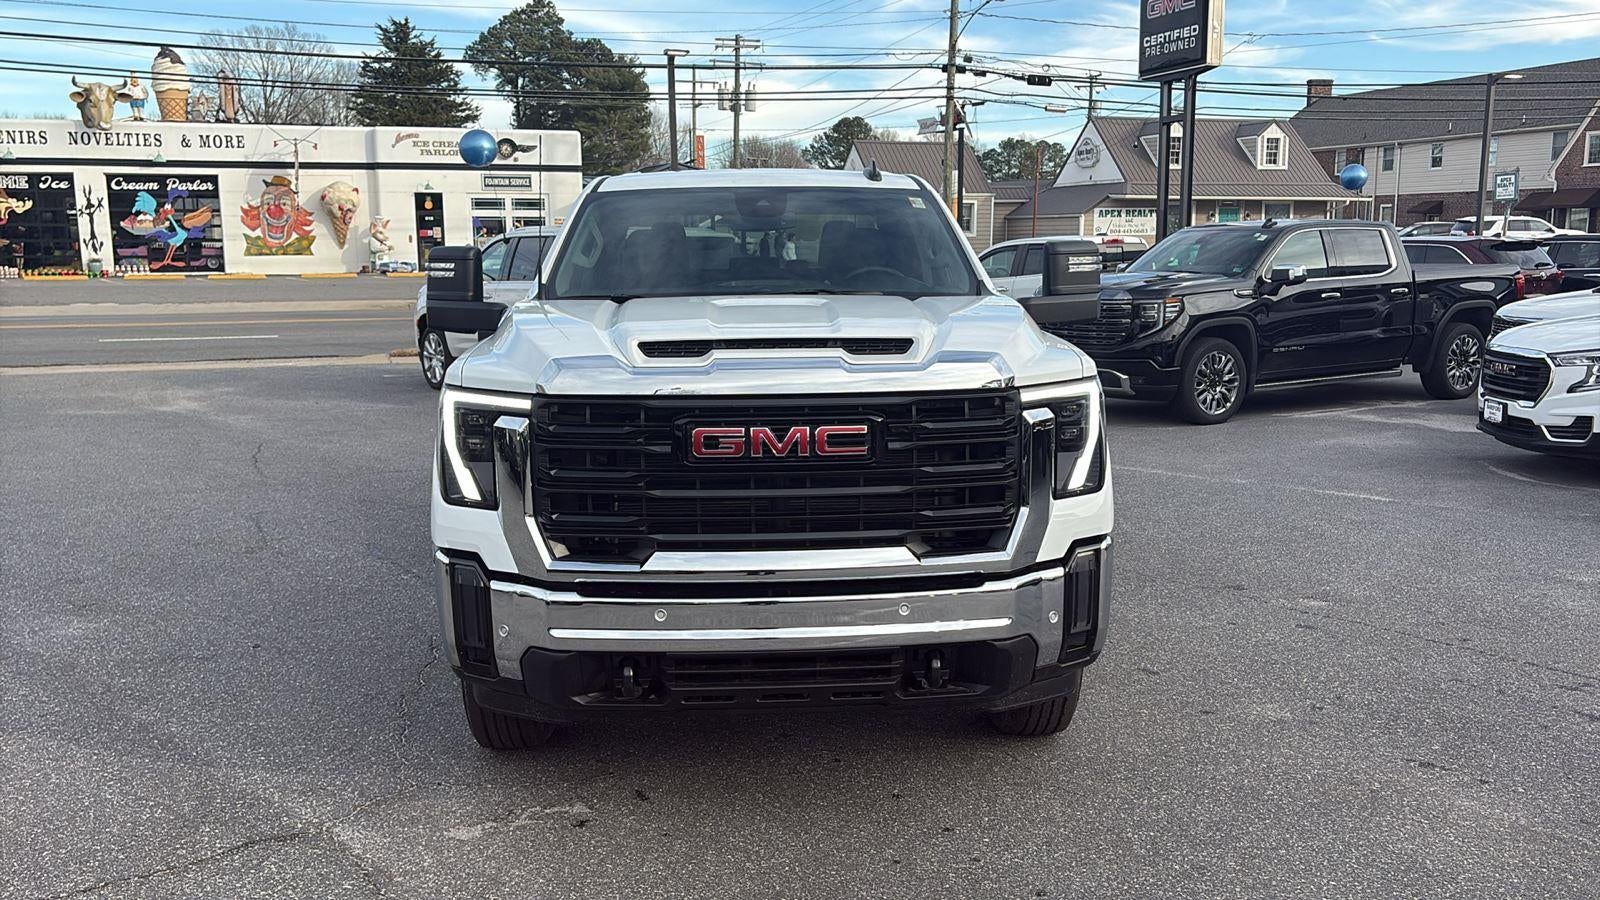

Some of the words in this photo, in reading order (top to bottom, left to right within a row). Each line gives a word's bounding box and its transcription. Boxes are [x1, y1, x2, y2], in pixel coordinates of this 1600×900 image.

[1147, 0, 1196, 19] GMC
[1143, 24, 1199, 47] CERTIFIED
[1145, 37, 1196, 58] PRE-OWNED
[67, 131, 163, 147] NOVELTIES
[180, 134, 192, 148] &
[199, 135, 245, 149] MORE
[412, 140, 430, 148] ICE
[432, 140, 460, 148] CREA
[39, 176, 71, 189] Ice
[110, 177, 160, 191] Cream
[166, 178, 216, 191] Parlor
[485, 177, 509, 186] FOUNTAIN
[510, 177, 530, 186] SERVICE
[1098, 209, 1122, 218] APEX
[691, 425, 868, 458] GMC
